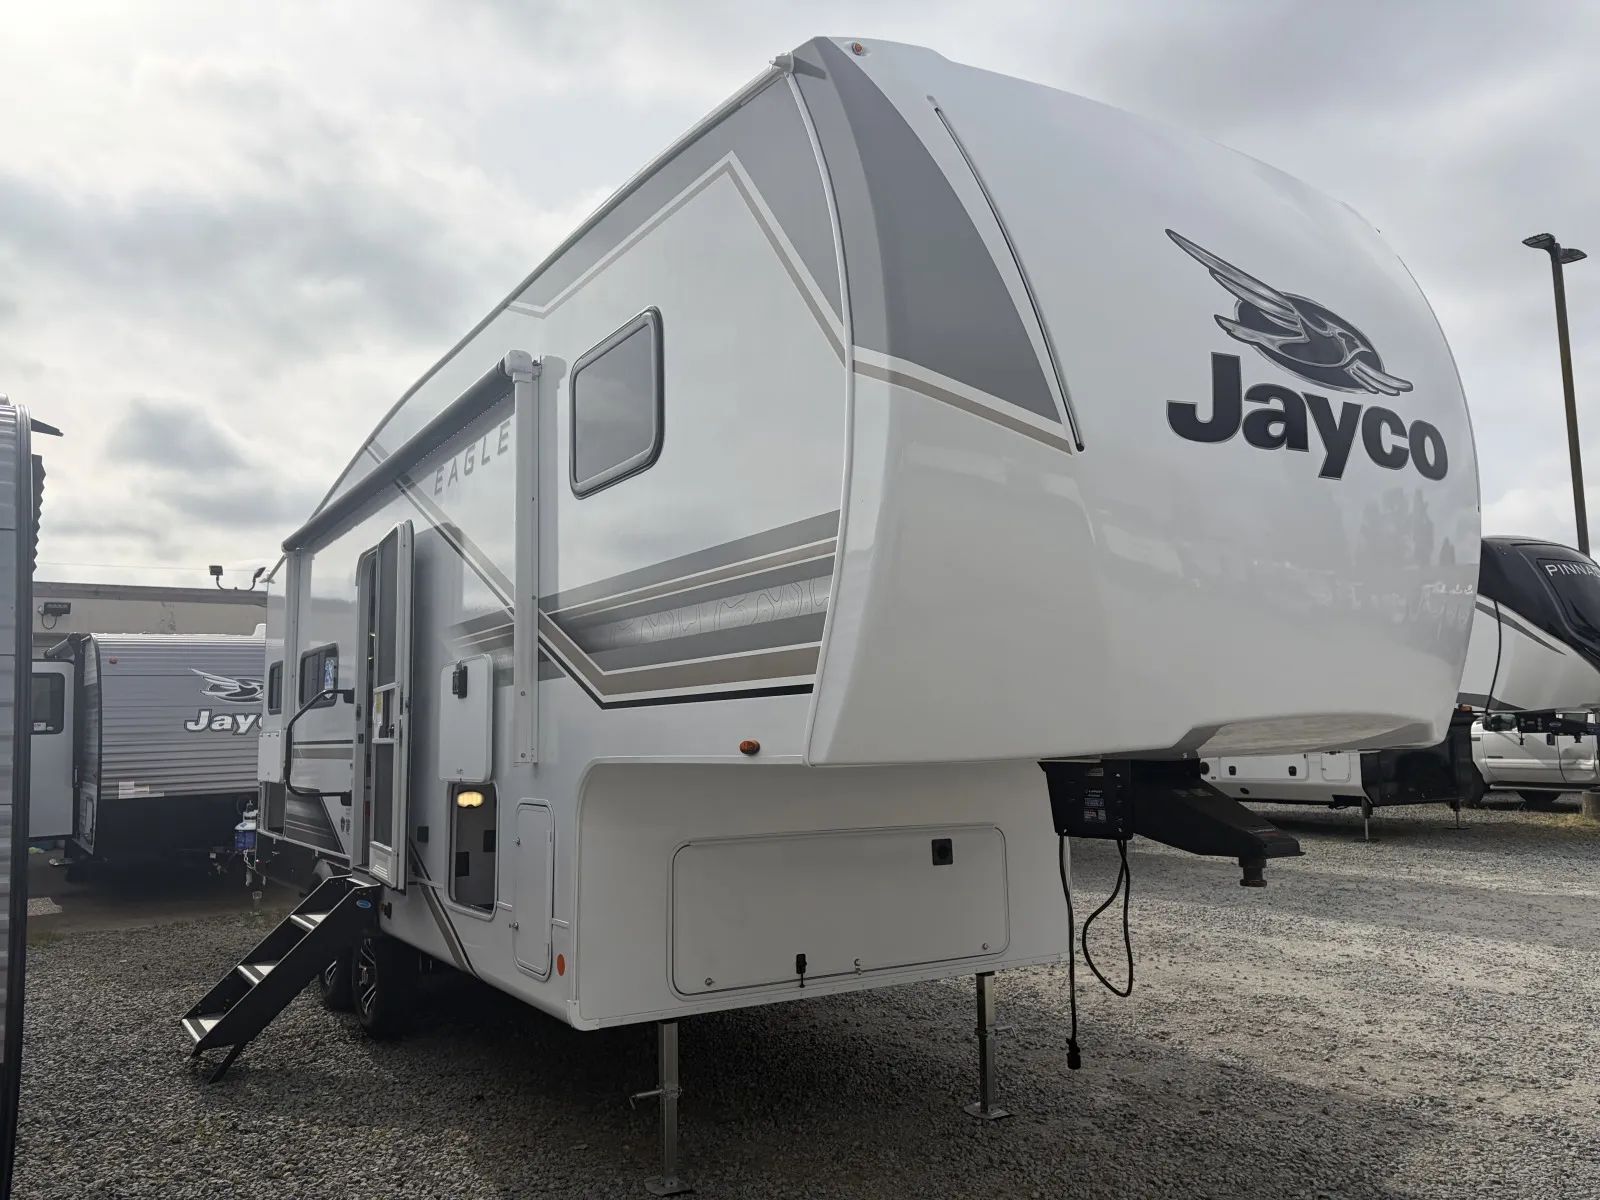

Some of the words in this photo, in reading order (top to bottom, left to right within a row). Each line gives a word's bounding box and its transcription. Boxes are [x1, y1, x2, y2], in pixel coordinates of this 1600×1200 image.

[1166, 352, 1449, 481] Jayco
[434, 420, 511, 496] EAGLE
[184, 709, 262, 736] Jay
